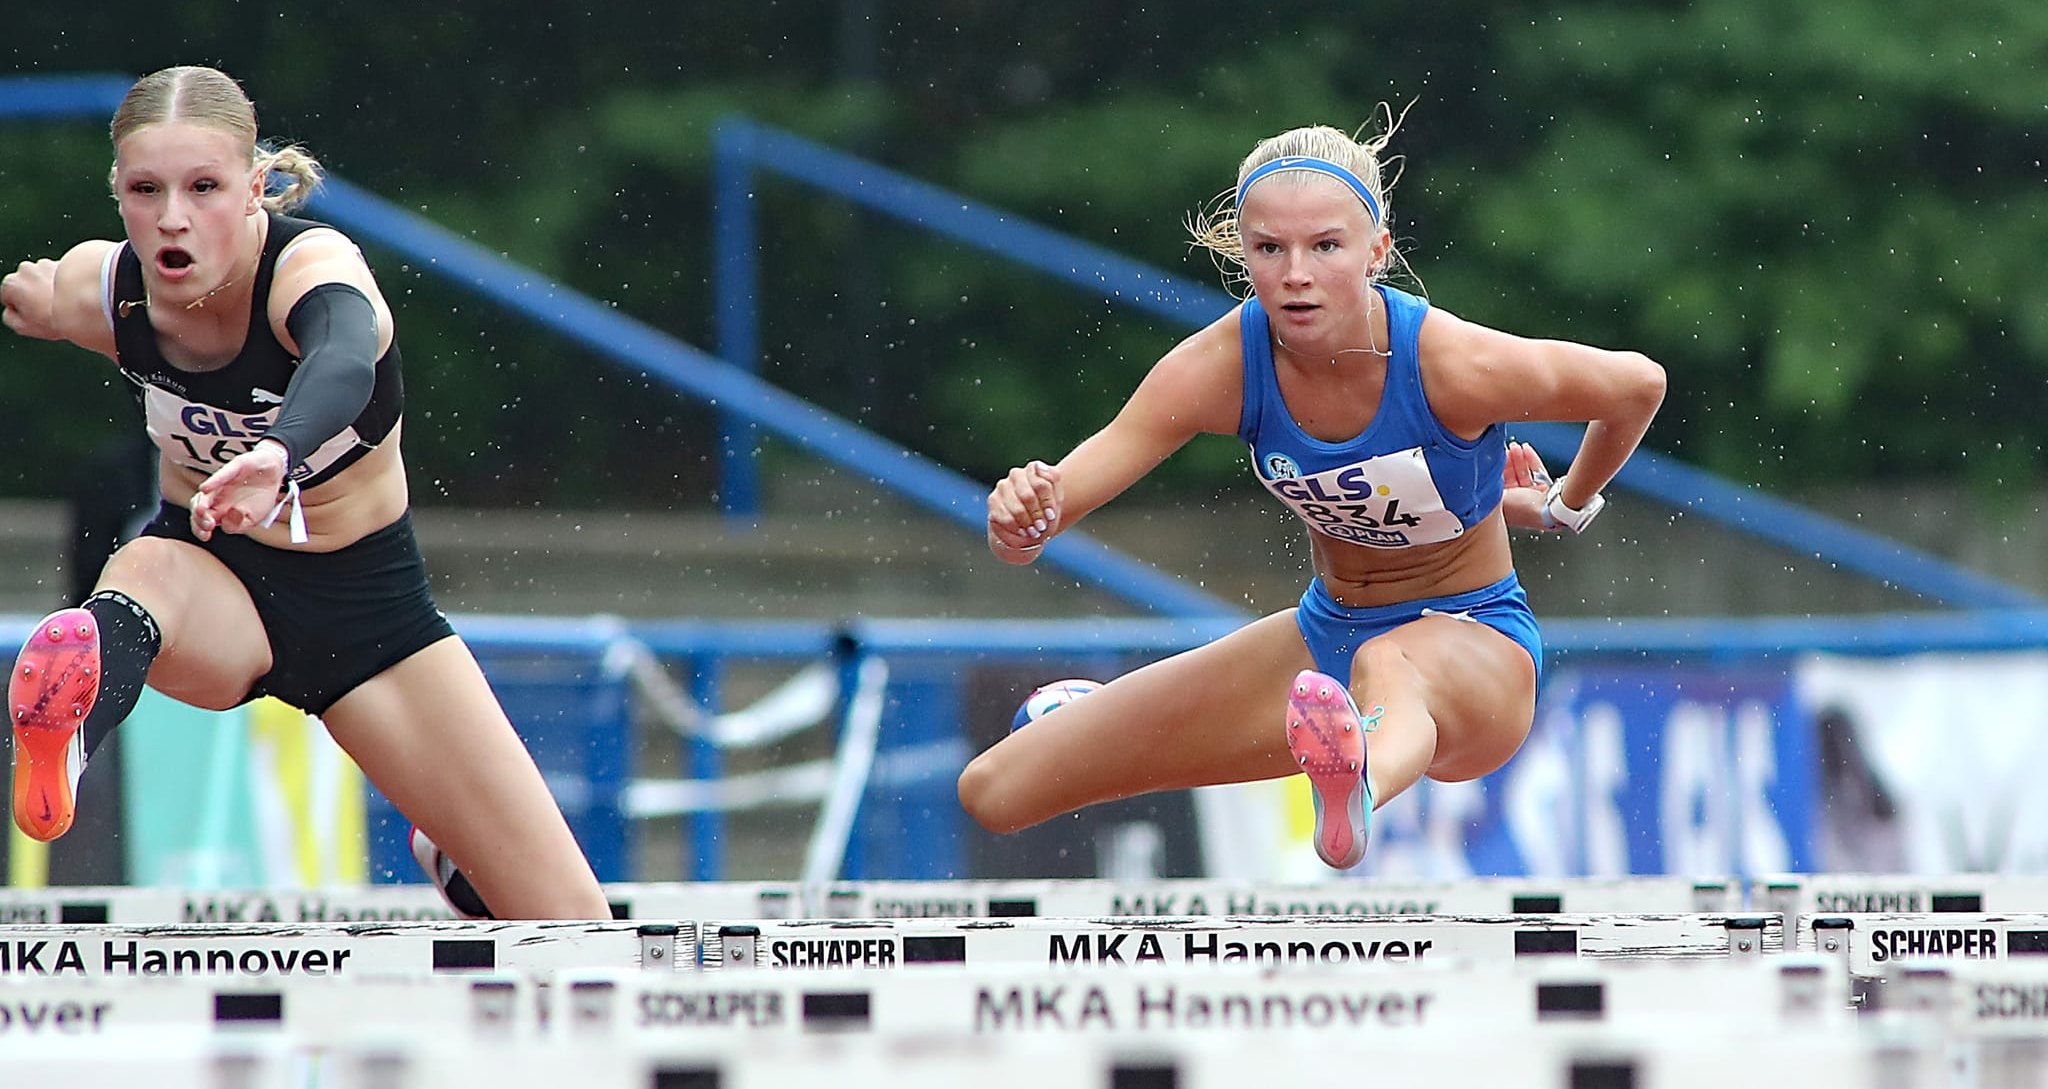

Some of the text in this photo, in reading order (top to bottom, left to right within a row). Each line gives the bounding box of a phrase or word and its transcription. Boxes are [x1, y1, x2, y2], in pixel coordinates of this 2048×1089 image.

[181, 406, 271, 438] GLS
[1271, 467, 1373, 501] GLS
[1110, 893, 1210, 916] MKA
[103, 940, 351, 976] Hannover
[771, 939, 896, 971] SCHÄPER
[1049, 932, 1433, 966] MKA Hannover
[1871, 928, 1997, 961] SCHÄPER
[973, 983, 1436, 1031] MKA Hannover
